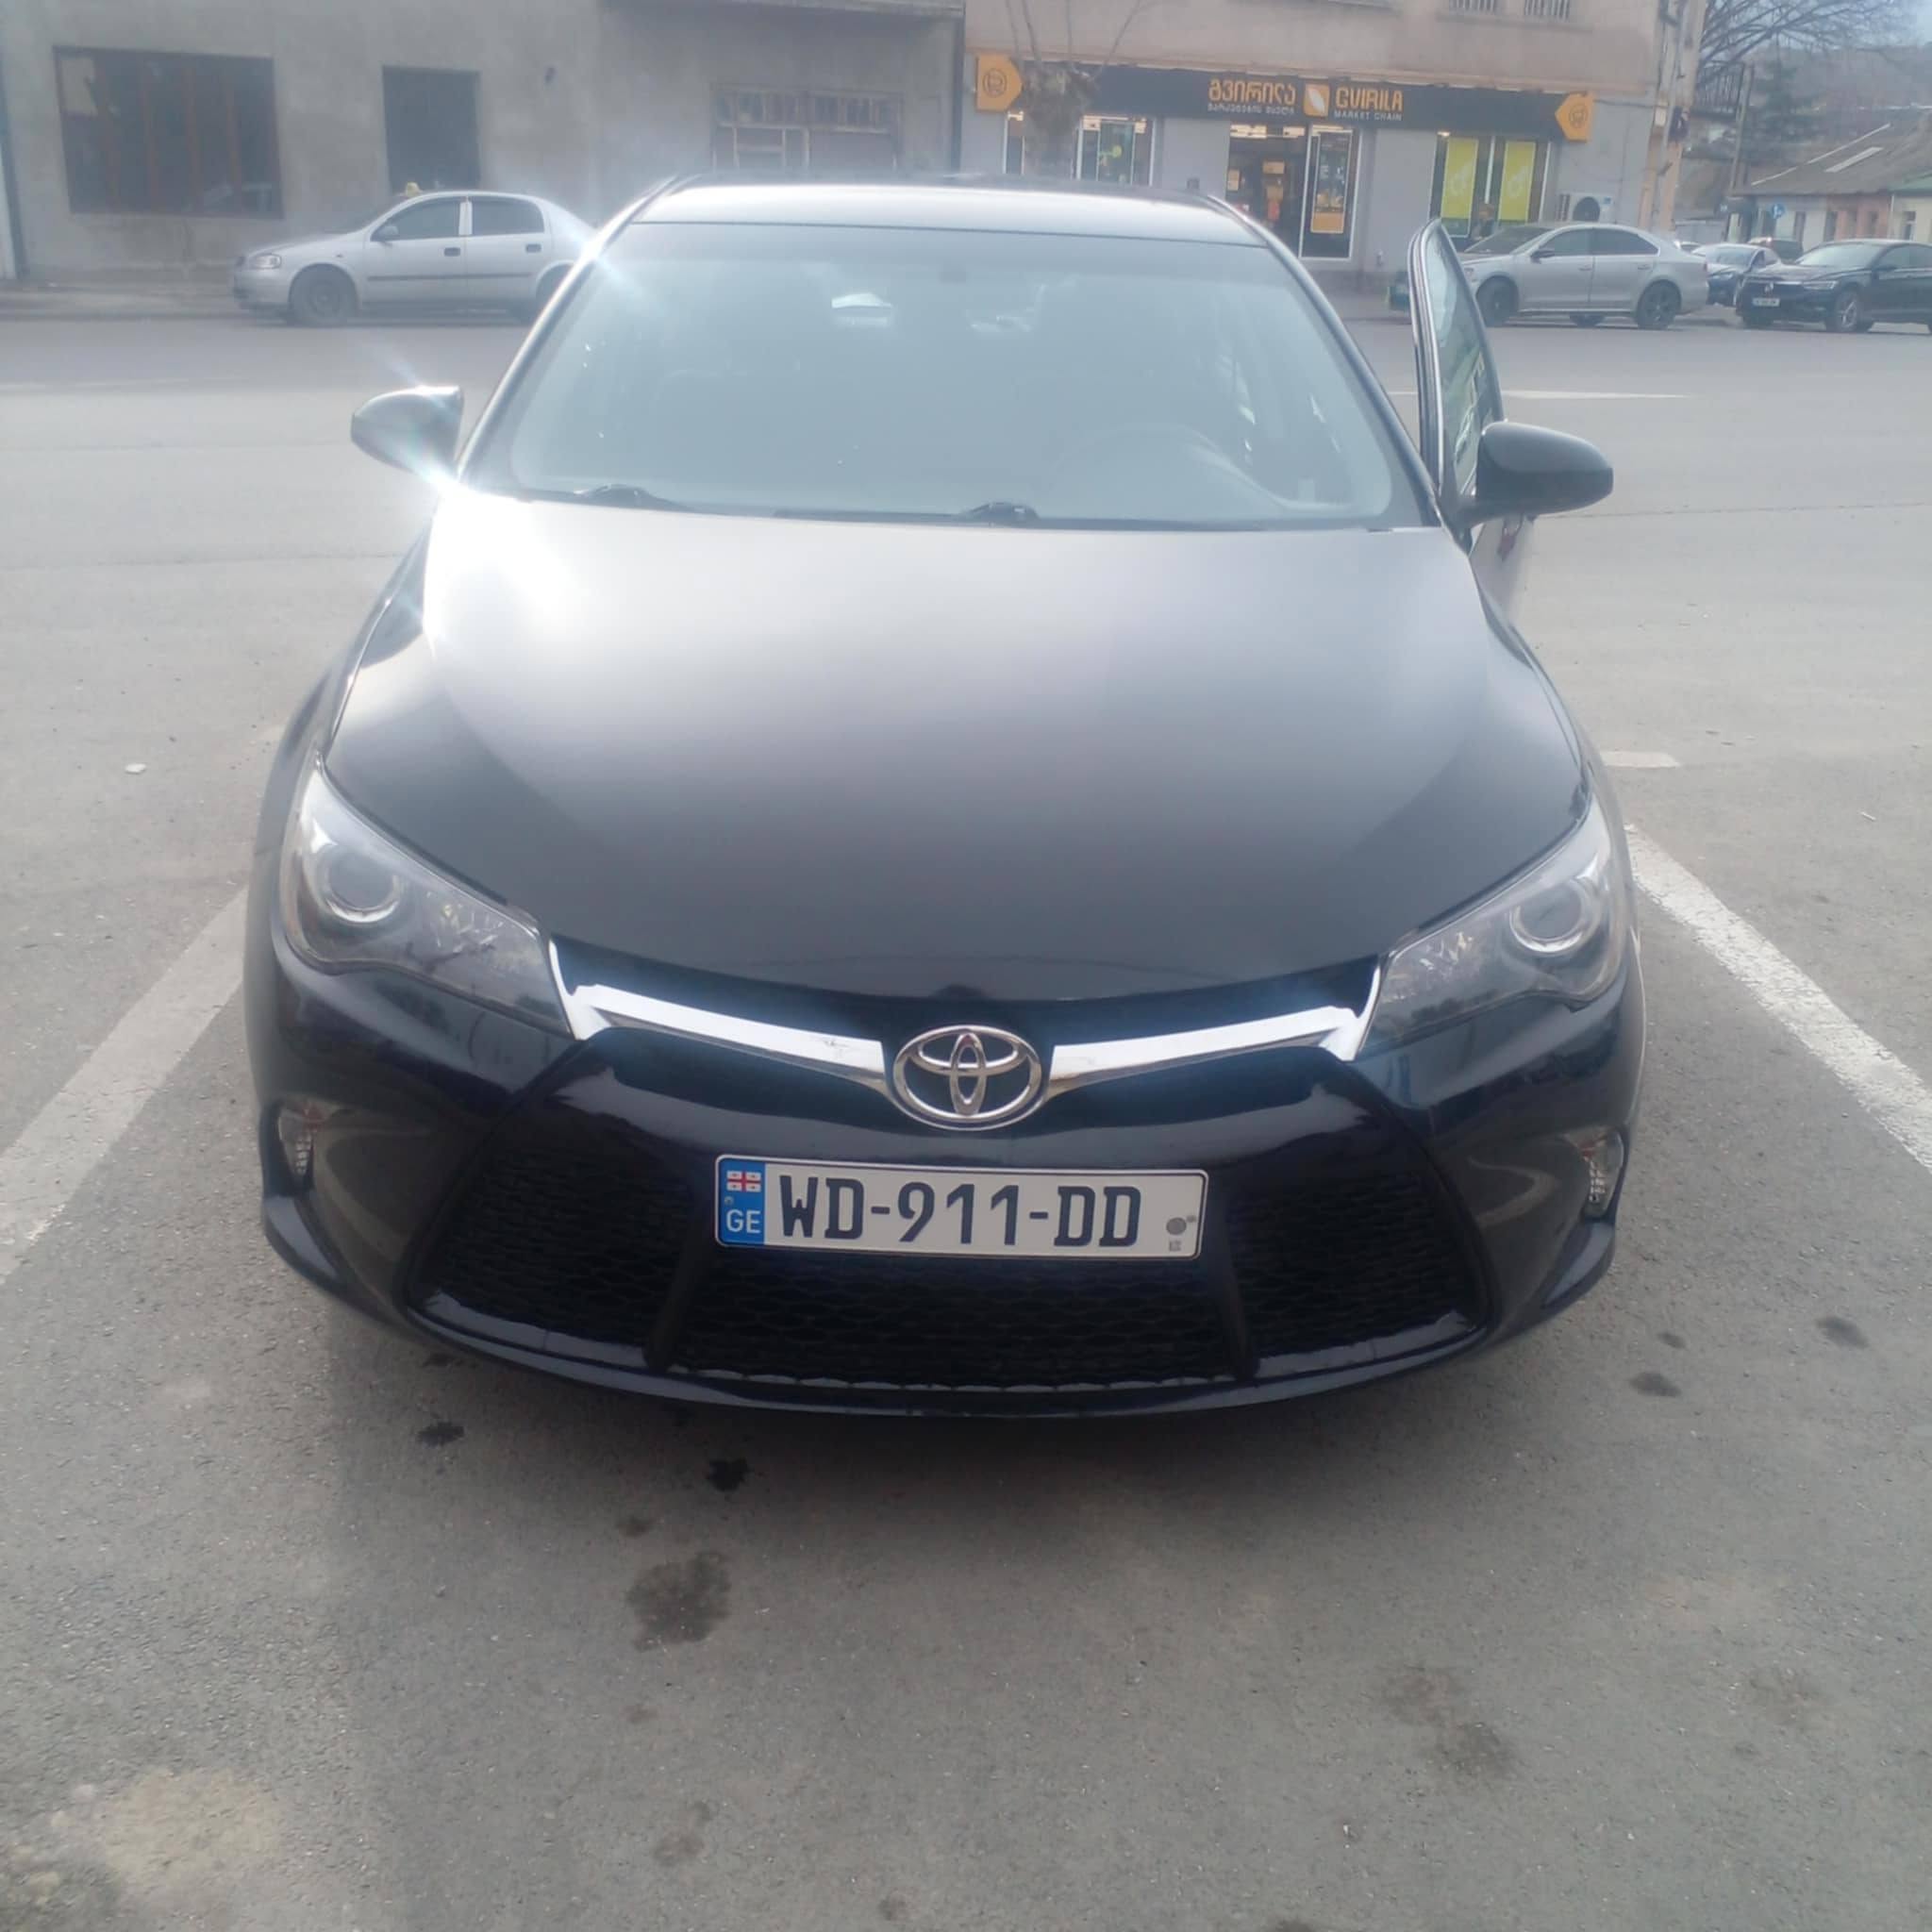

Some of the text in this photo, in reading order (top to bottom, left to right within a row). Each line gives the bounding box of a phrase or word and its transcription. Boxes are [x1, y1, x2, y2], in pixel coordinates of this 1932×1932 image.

[1208, 79, 1296, 106] გვირილა
[1336, 86, 1403, 111] GVIRILA
[726, 1208, 761, 1234] GE
[779, 1174, 1141, 1247] WD-911-DD
